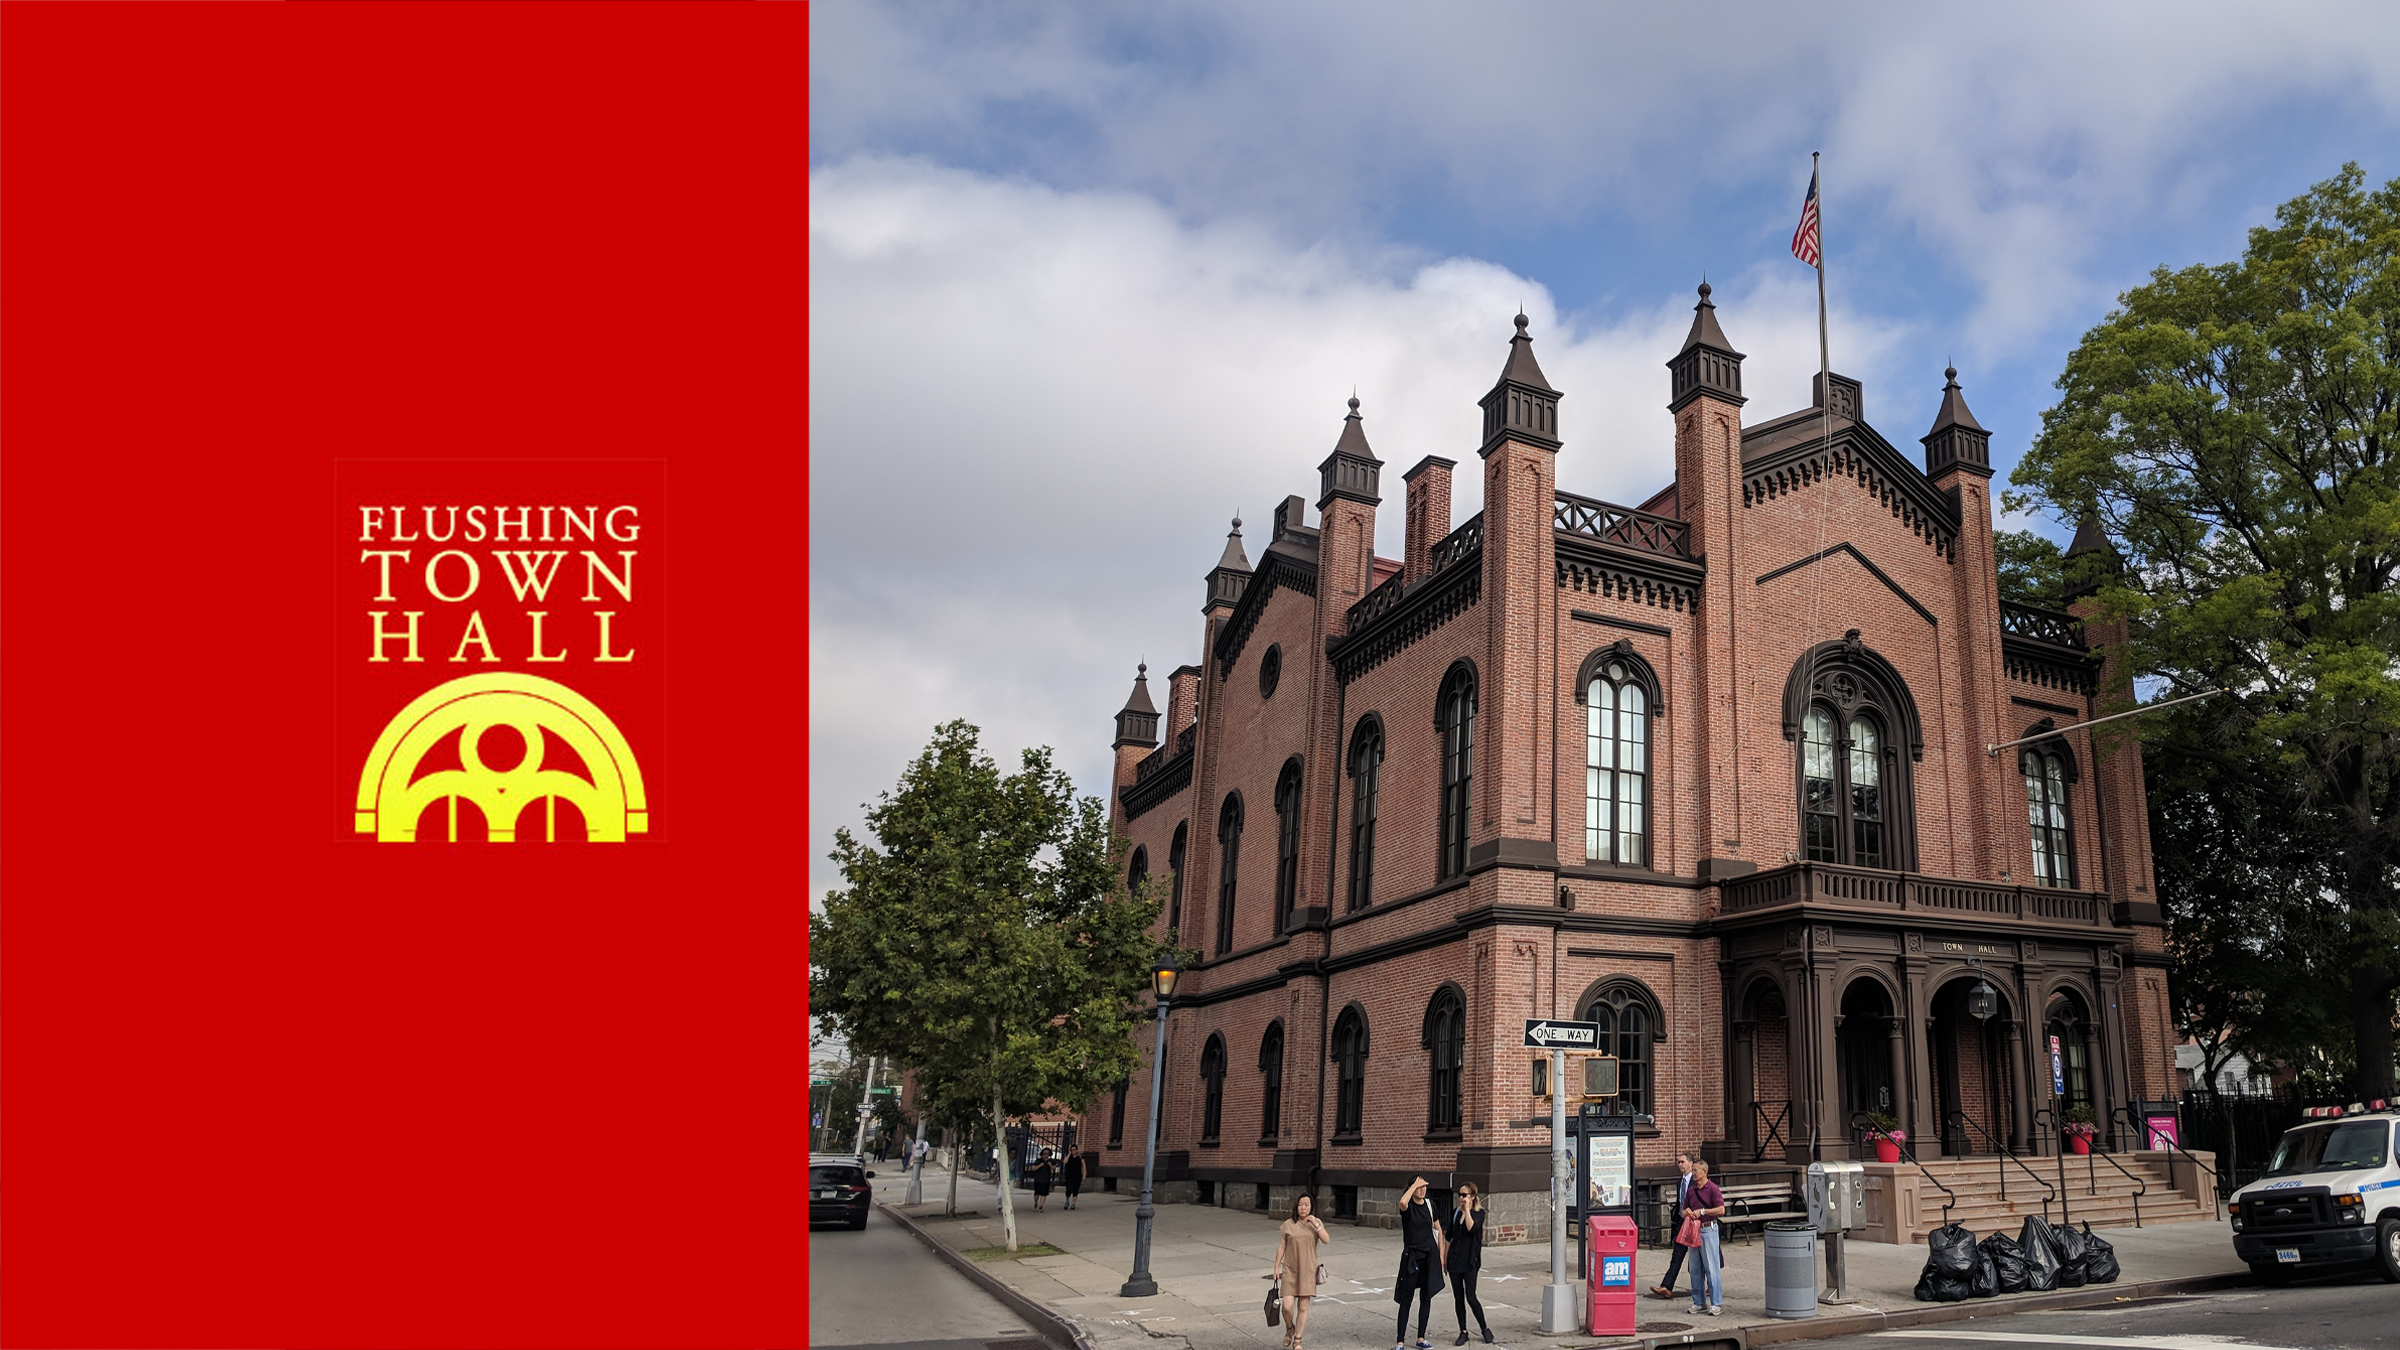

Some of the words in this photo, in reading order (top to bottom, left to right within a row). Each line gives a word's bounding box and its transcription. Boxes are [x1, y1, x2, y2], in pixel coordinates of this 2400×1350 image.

[1942, 942, 1963, 951] TOWN
[1978, 945, 1997, 954] HALL
[1536, 1028, 1557, 1039] ONE
[1567, 1029, 1589, 1041] WAY
[2264, 1180, 2303, 1190] POLICE
[2364, 1182, 2382, 1192] POLICE
[1604, 1261, 1629, 1276] am
